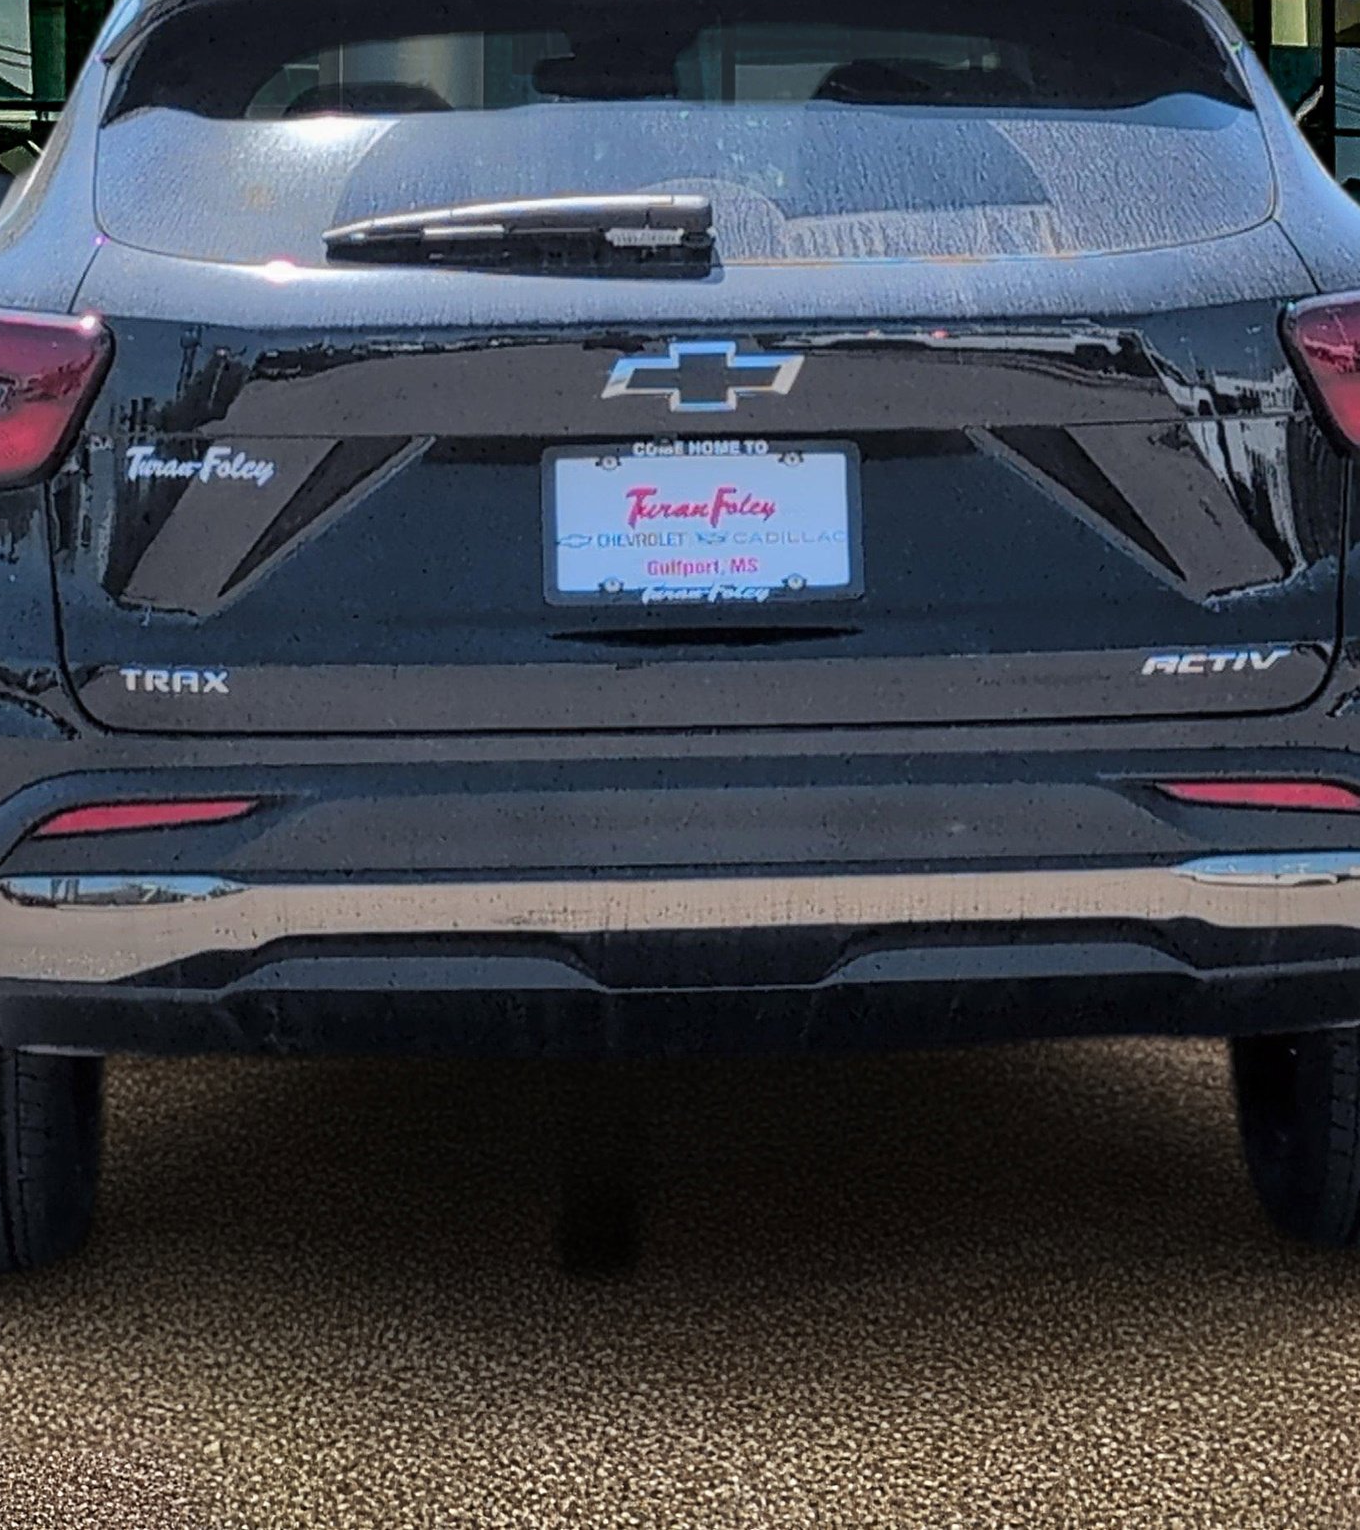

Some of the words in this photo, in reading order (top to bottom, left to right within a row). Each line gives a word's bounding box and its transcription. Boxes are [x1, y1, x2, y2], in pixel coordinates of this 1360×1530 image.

[688, 439, 740, 454] HOME
[743, 439, 769, 454] TO
[126, 445, 198, 482] Turan
[199, 445, 274, 486] Foley
[626, 487, 709, 529] Turan
[710, 486, 775, 528] Foley
[597, 532, 683, 548] CHEVROLET
[733, 530, 845, 545] CADILLAC
[647, 560, 725, 577] Gulfport,
[730, 558, 758, 573] MS
[1141, 649, 1291, 676] ACTIV
[120, 669, 230, 693] TRAX
